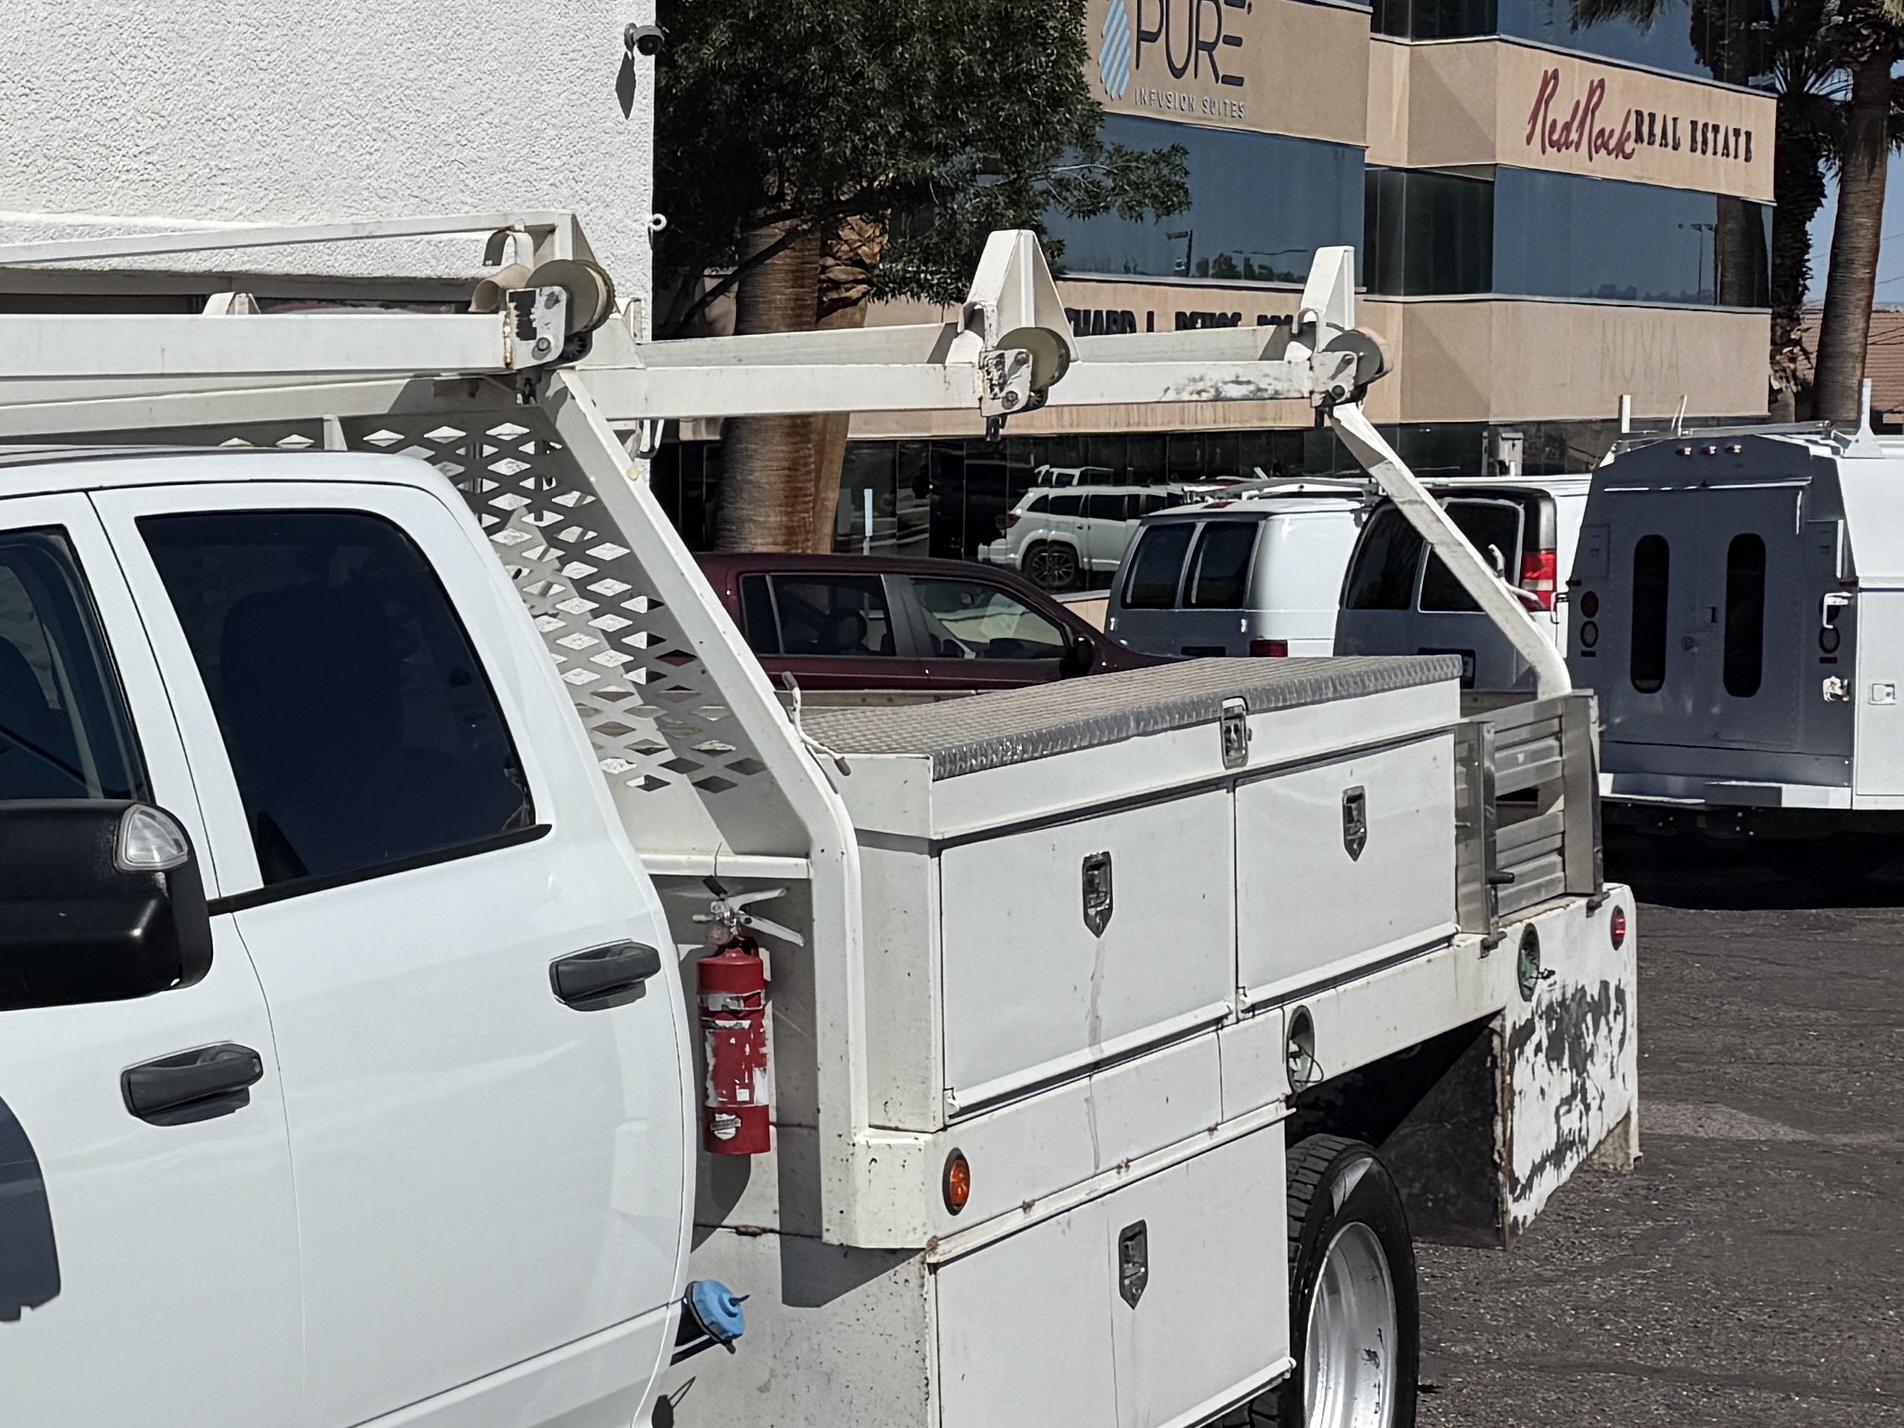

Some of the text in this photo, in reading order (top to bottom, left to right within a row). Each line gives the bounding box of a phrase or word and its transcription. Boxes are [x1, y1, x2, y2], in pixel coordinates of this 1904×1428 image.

[1134, 87, 1246, 119] INFUSION SUITES
[1634, 109, 1681, 152] REAL
[1689, 119, 1753, 163] ESTATE
